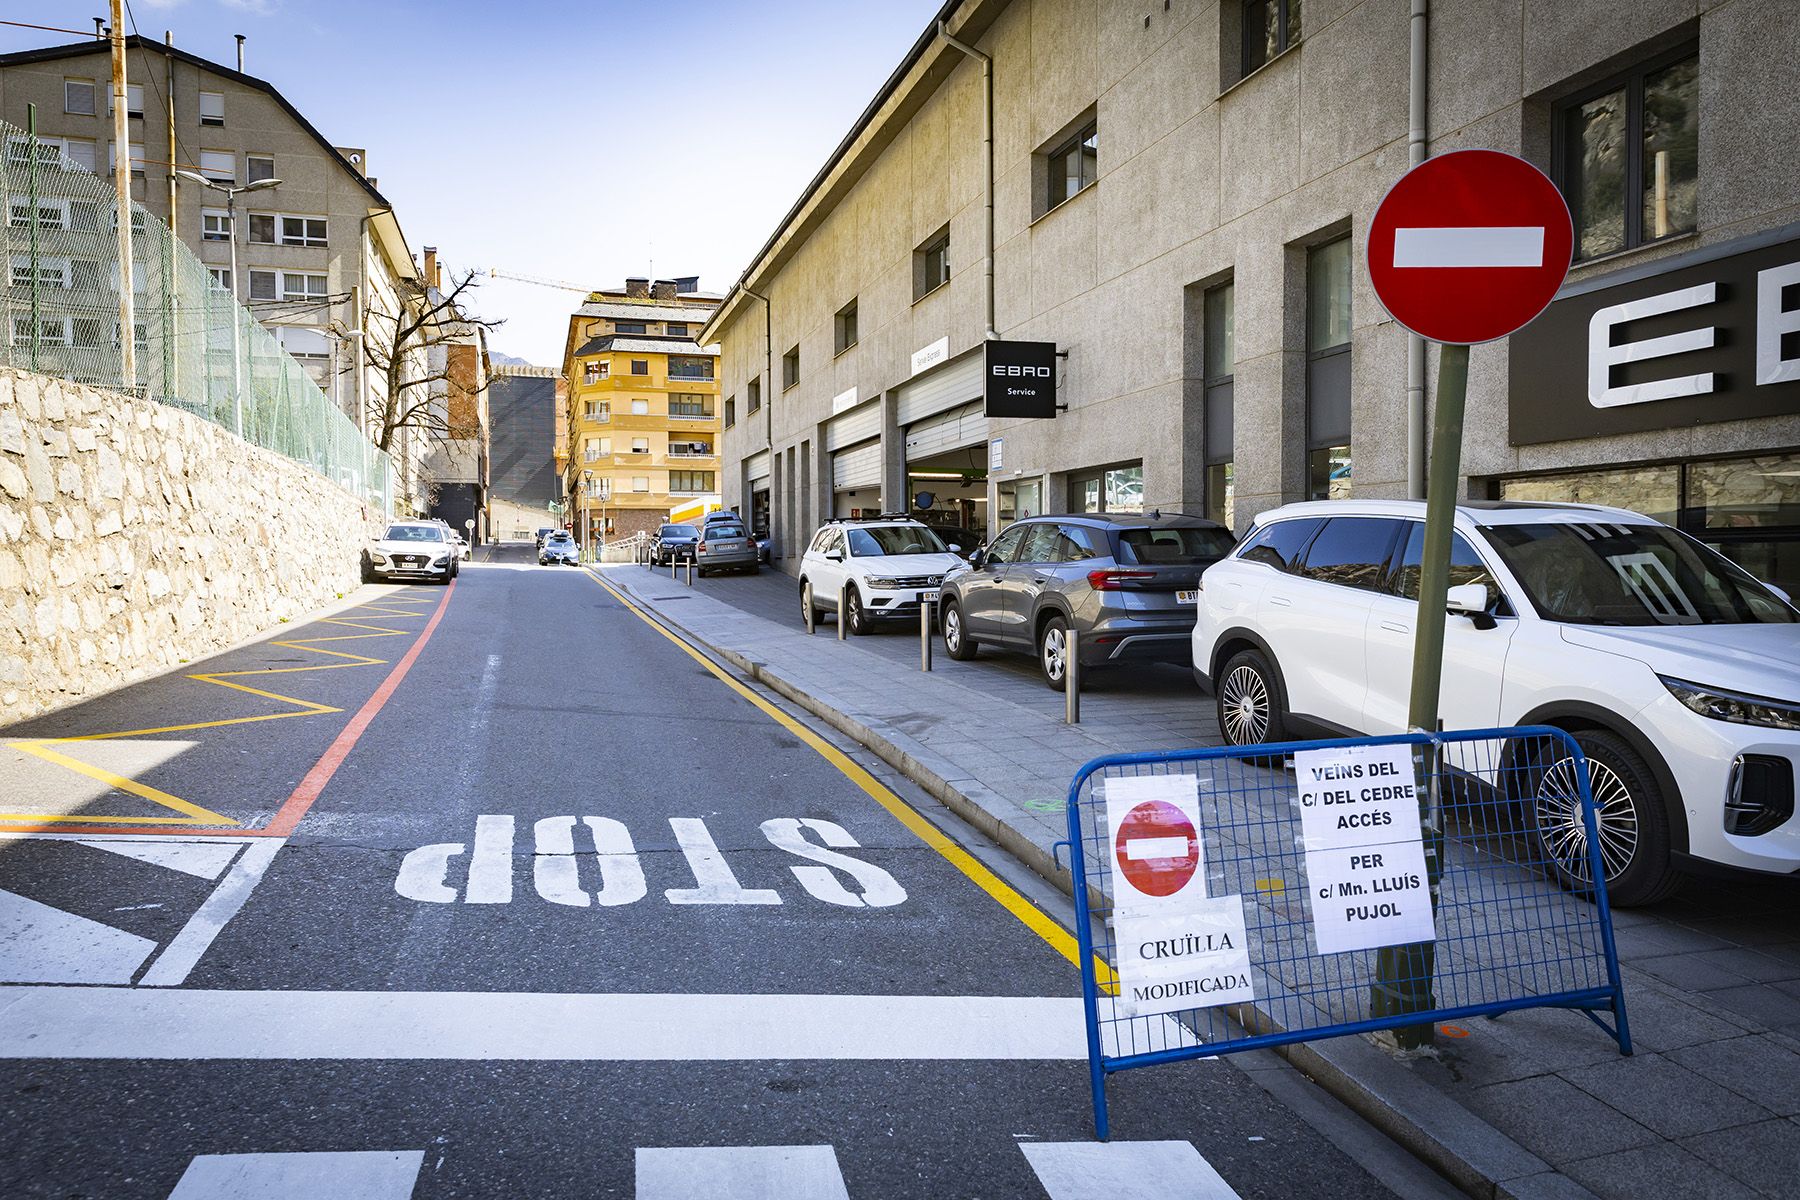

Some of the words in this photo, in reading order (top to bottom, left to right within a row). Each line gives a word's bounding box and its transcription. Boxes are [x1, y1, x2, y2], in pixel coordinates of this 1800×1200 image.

[992, 365, 1050, 377] EBRO
[1007, 387, 1036, 396] Service
[1311, 763, 1363, 781] VEÏNS
[1368, 762, 1399, 777] DEL
[1301, 793, 1318, 807] C/
[1323, 790, 1355, 805] DEL
[1360, 785, 1414, 802] CEDRE
[1336, 809, 1392, 829] ACCÉS
[395, 814, 908, 907] STOP
[1350, 854, 1384, 870] PER
[1319, 884, 1333, 898] c/
[1338, 882, 1367, 897] Mn.
[1372, 872, 1420, 893] LLUÍS
[1346, 903, 1401, 922] PUJOL
[1139, 932, 1234, 960] CRUÏLLA
[1133, 973, 1250, 1002] MODIFICADA
